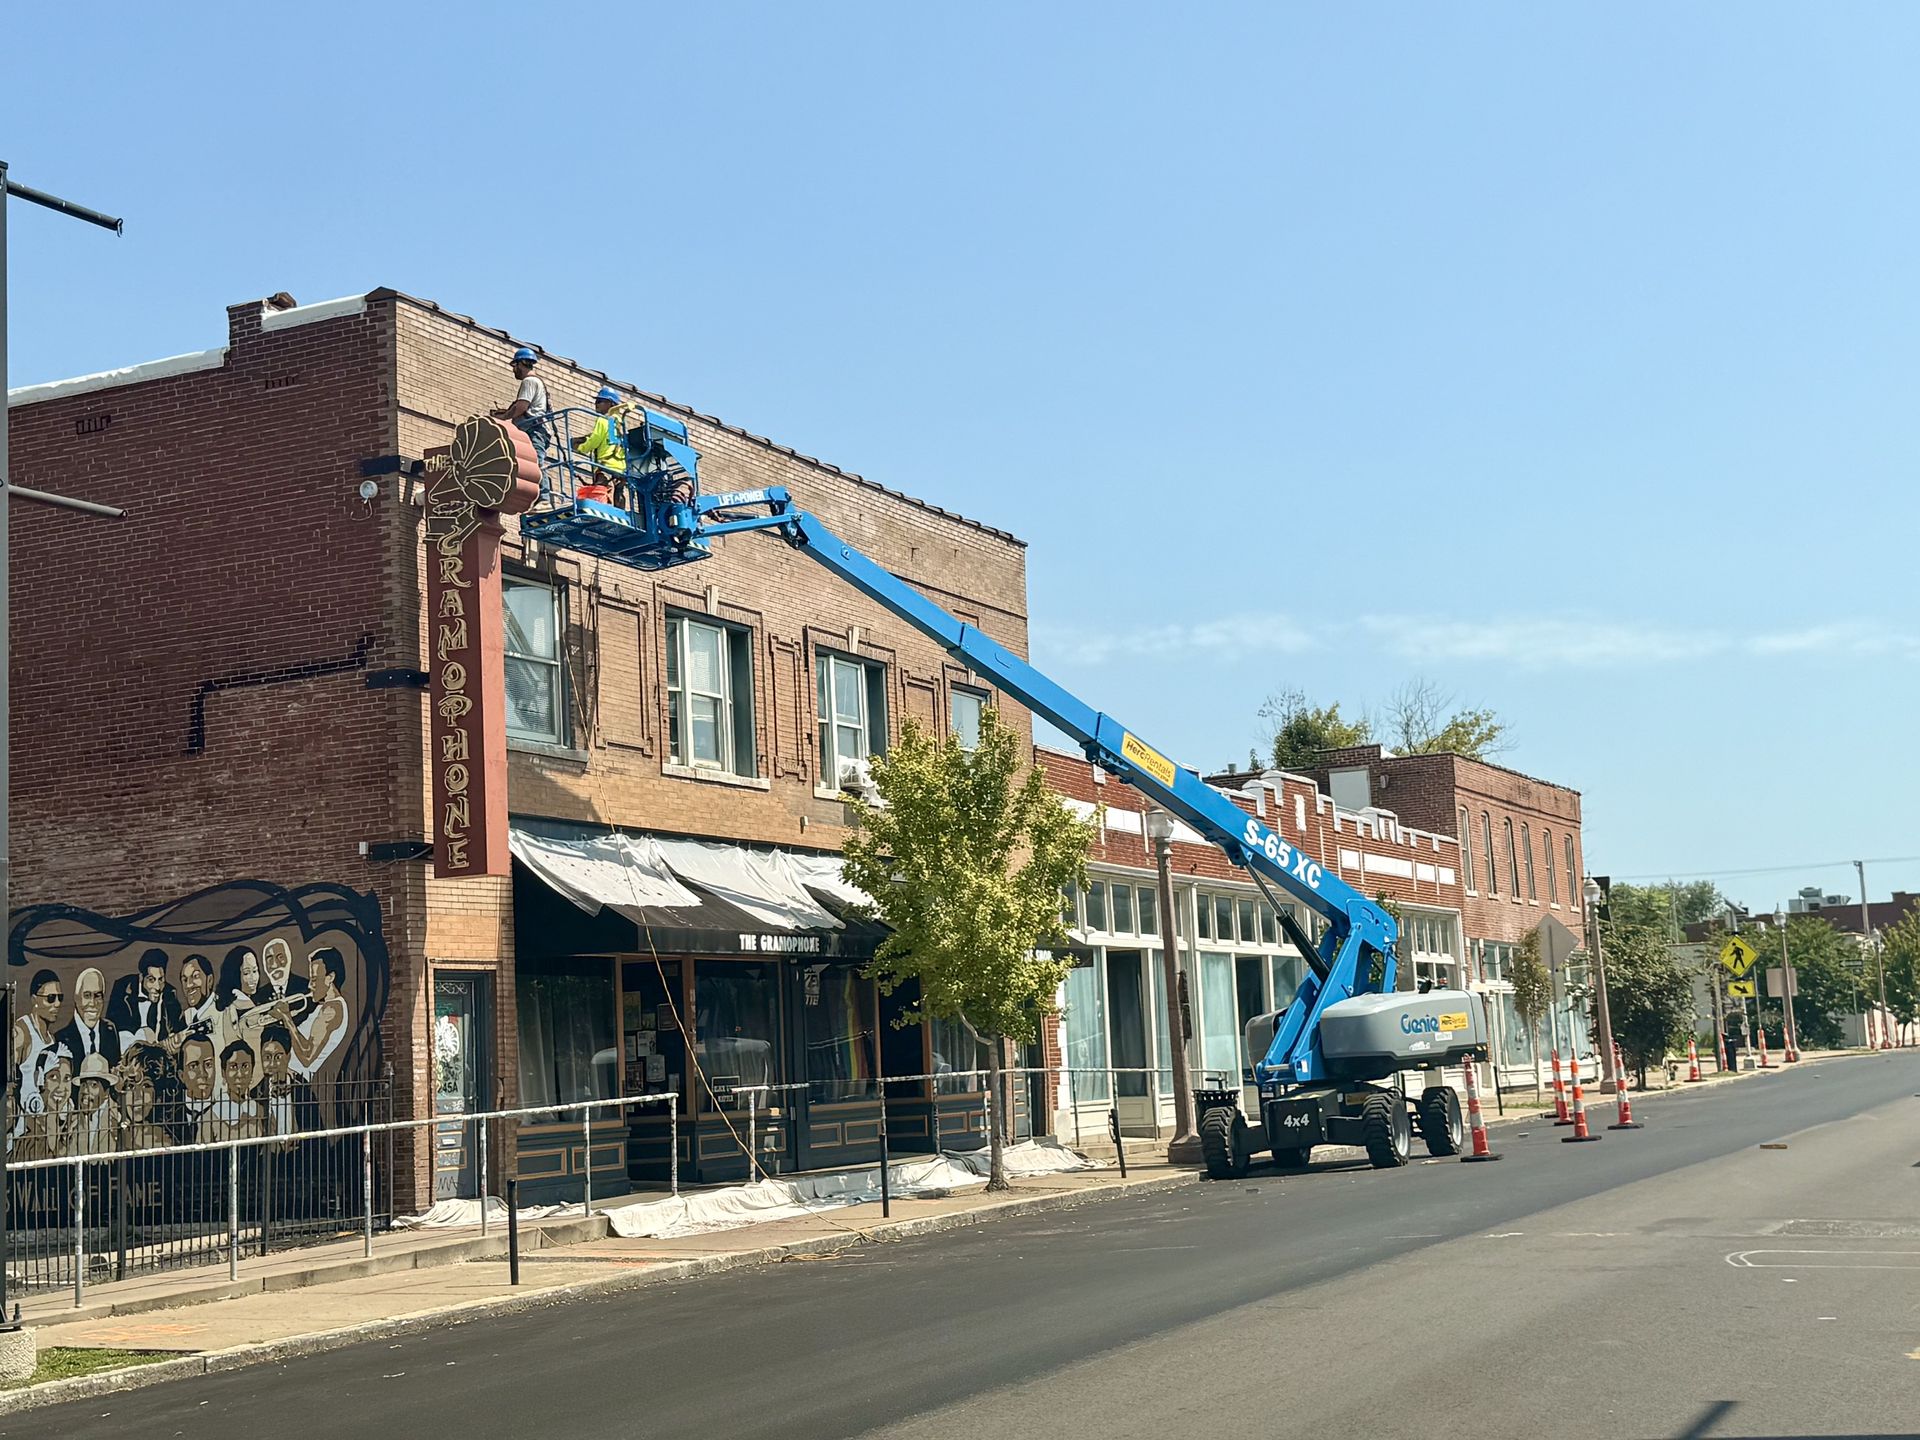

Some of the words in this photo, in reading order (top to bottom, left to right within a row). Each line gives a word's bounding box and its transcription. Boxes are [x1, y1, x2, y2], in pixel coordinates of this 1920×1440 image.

[423, 454, 451, 473] THE
[438, 522, 473, 869] GRAMOPHONE
[1126, 741, 1172, 778] HercRentals
[1243, 819, 1291, 868] S-65
[1292, 851, 1322, 889] XC
[739, 934, 757, 951] THE
[760, 934, 820, 953] GRAMOPHONE
[1400, 1013, 1439, 1034] Genie
[1283, 1113, 1310, 1127] 4x4
